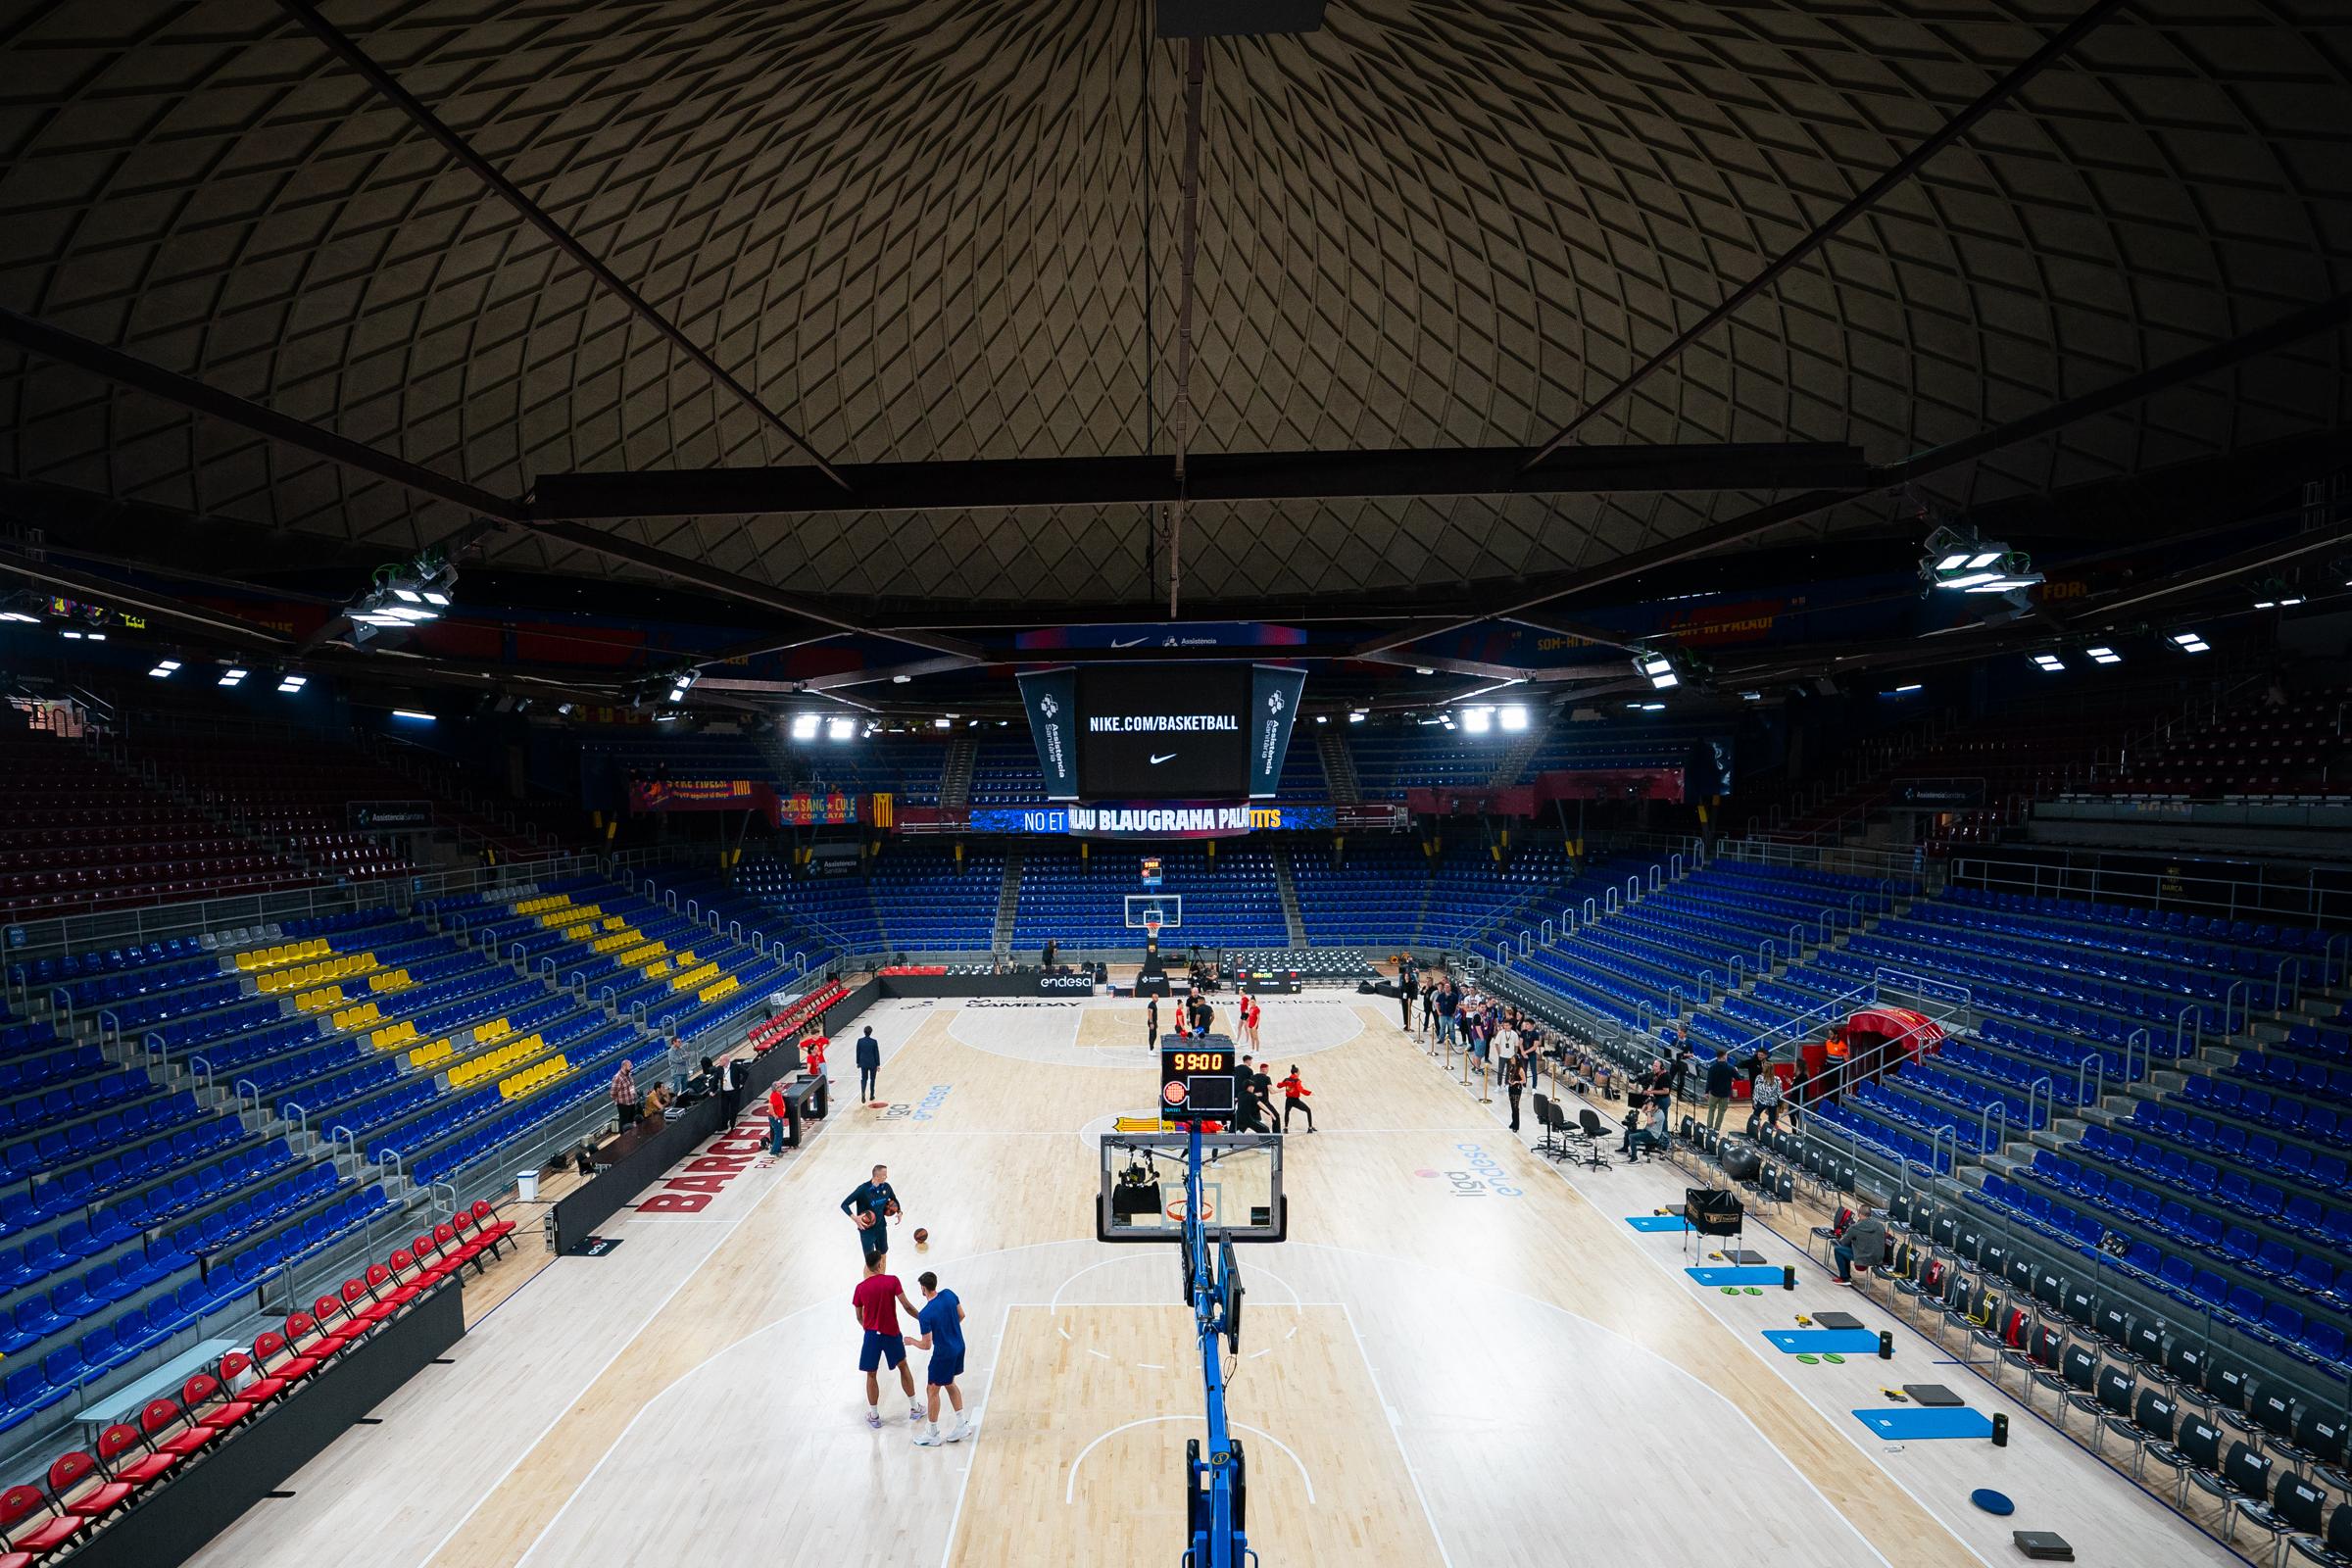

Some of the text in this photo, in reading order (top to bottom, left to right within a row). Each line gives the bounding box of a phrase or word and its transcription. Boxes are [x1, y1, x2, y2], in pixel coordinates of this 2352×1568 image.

[55, 597, 66, 612] 4
[1537, 637, 1578, 651] SOM-HI
[1090, 715, 1239, 732] NIKE.COM/BASKETBALL
[1052, 723, 1065, 778] Assistència
[1265, 719, 1279, 775] Assistència
[801, 799, 825, 812] SANG
[1024, 811, 1045, 831] NO
[1049, 811, 1064, 831] ET
[1068, 808, 1097, 831] ALAU
[1099, 808, 1216, 831] BLAUGRANA
[1040, 976, 1092, 988] endesa
[1174, 1054, 1222, 1070] 99:00
[875, 1085, 954, 1121] liga endesa
[1444, 1144, 1524, 1198] liga endesa
